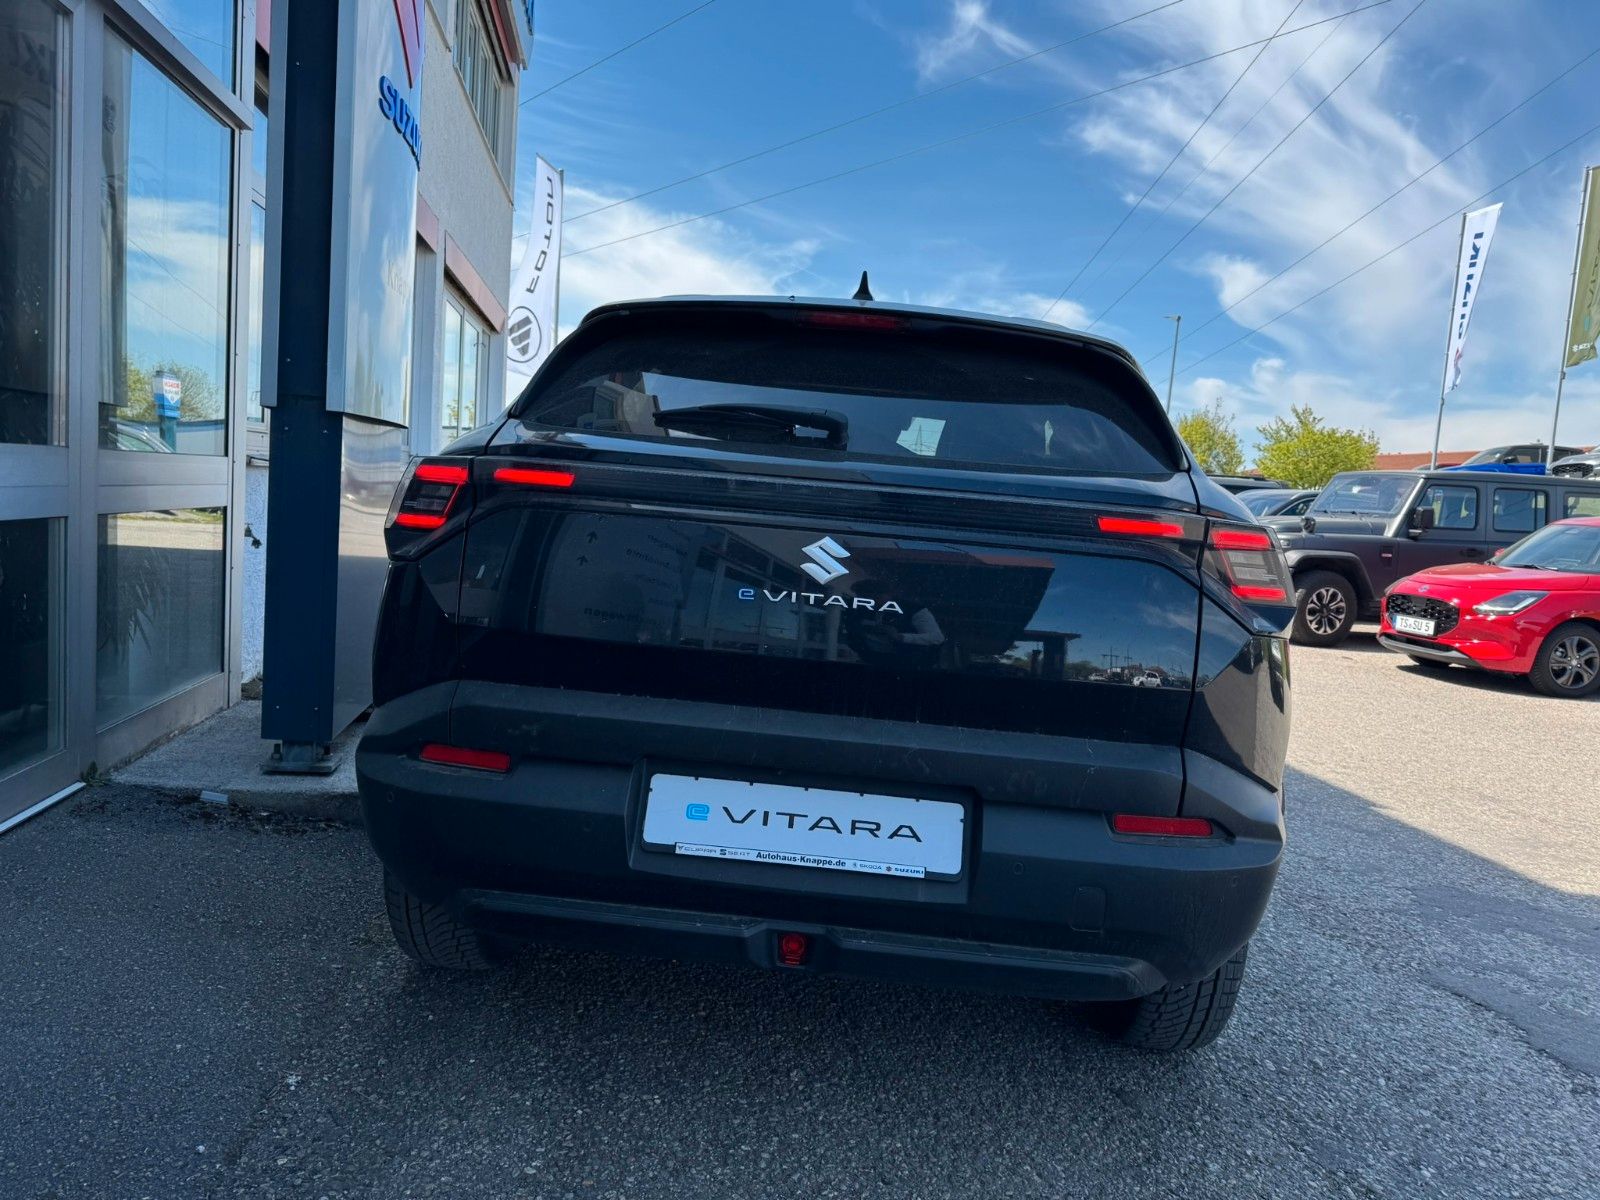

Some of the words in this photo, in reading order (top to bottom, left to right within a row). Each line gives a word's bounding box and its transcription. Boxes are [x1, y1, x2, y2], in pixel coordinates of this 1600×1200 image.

[762, 589, 904, 614] VITARA
[722, 806, 922, 842] VITARA
[756, 851, 846, 867] Autohaus-Knappe.de
[894, 867, 924, 875] SUZUKI
